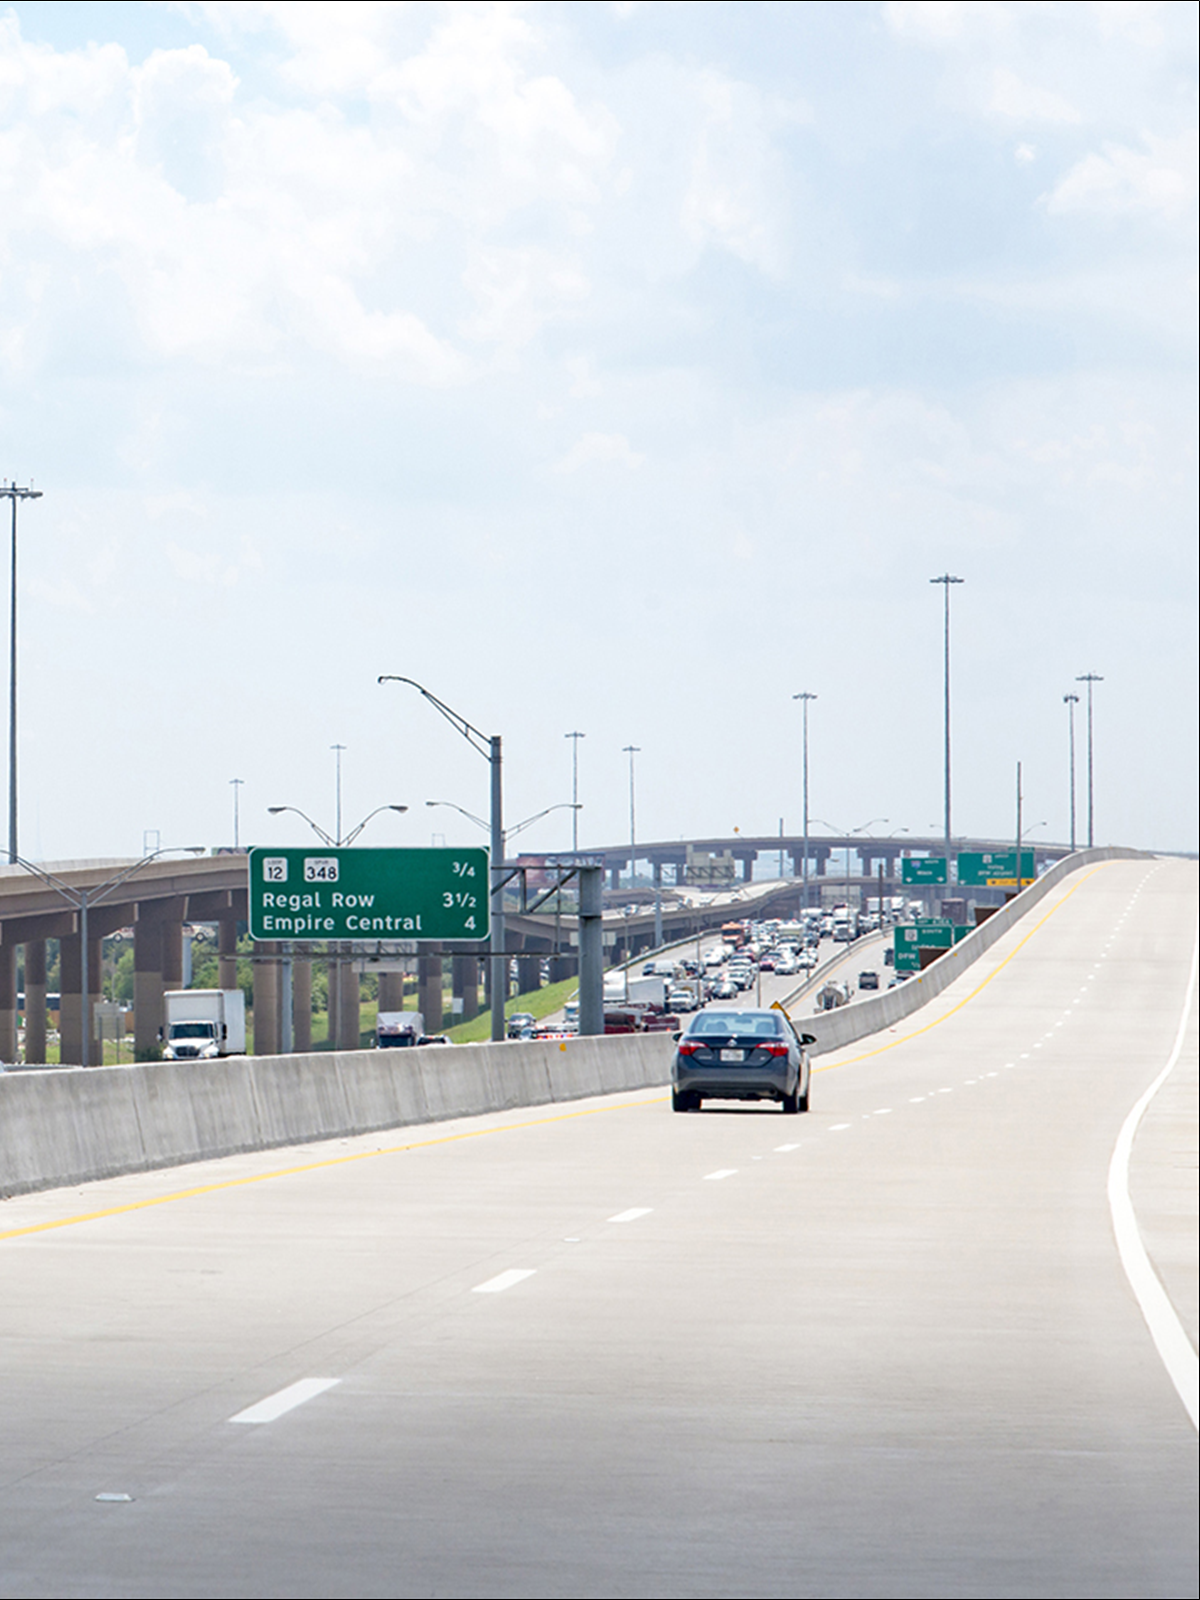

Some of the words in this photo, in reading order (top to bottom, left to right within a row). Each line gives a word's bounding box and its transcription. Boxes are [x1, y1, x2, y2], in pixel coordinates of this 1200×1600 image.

[267, 866, 283, 879] 12
[306, 866, 337, 880] 348
[263, 892, 321, 912] Regal
[332, 892, 375, 908] Row
[263, 914, 335, 934] Empire
[346, 914, 422, 931] Central
[464, 915, 476, 931] 4
